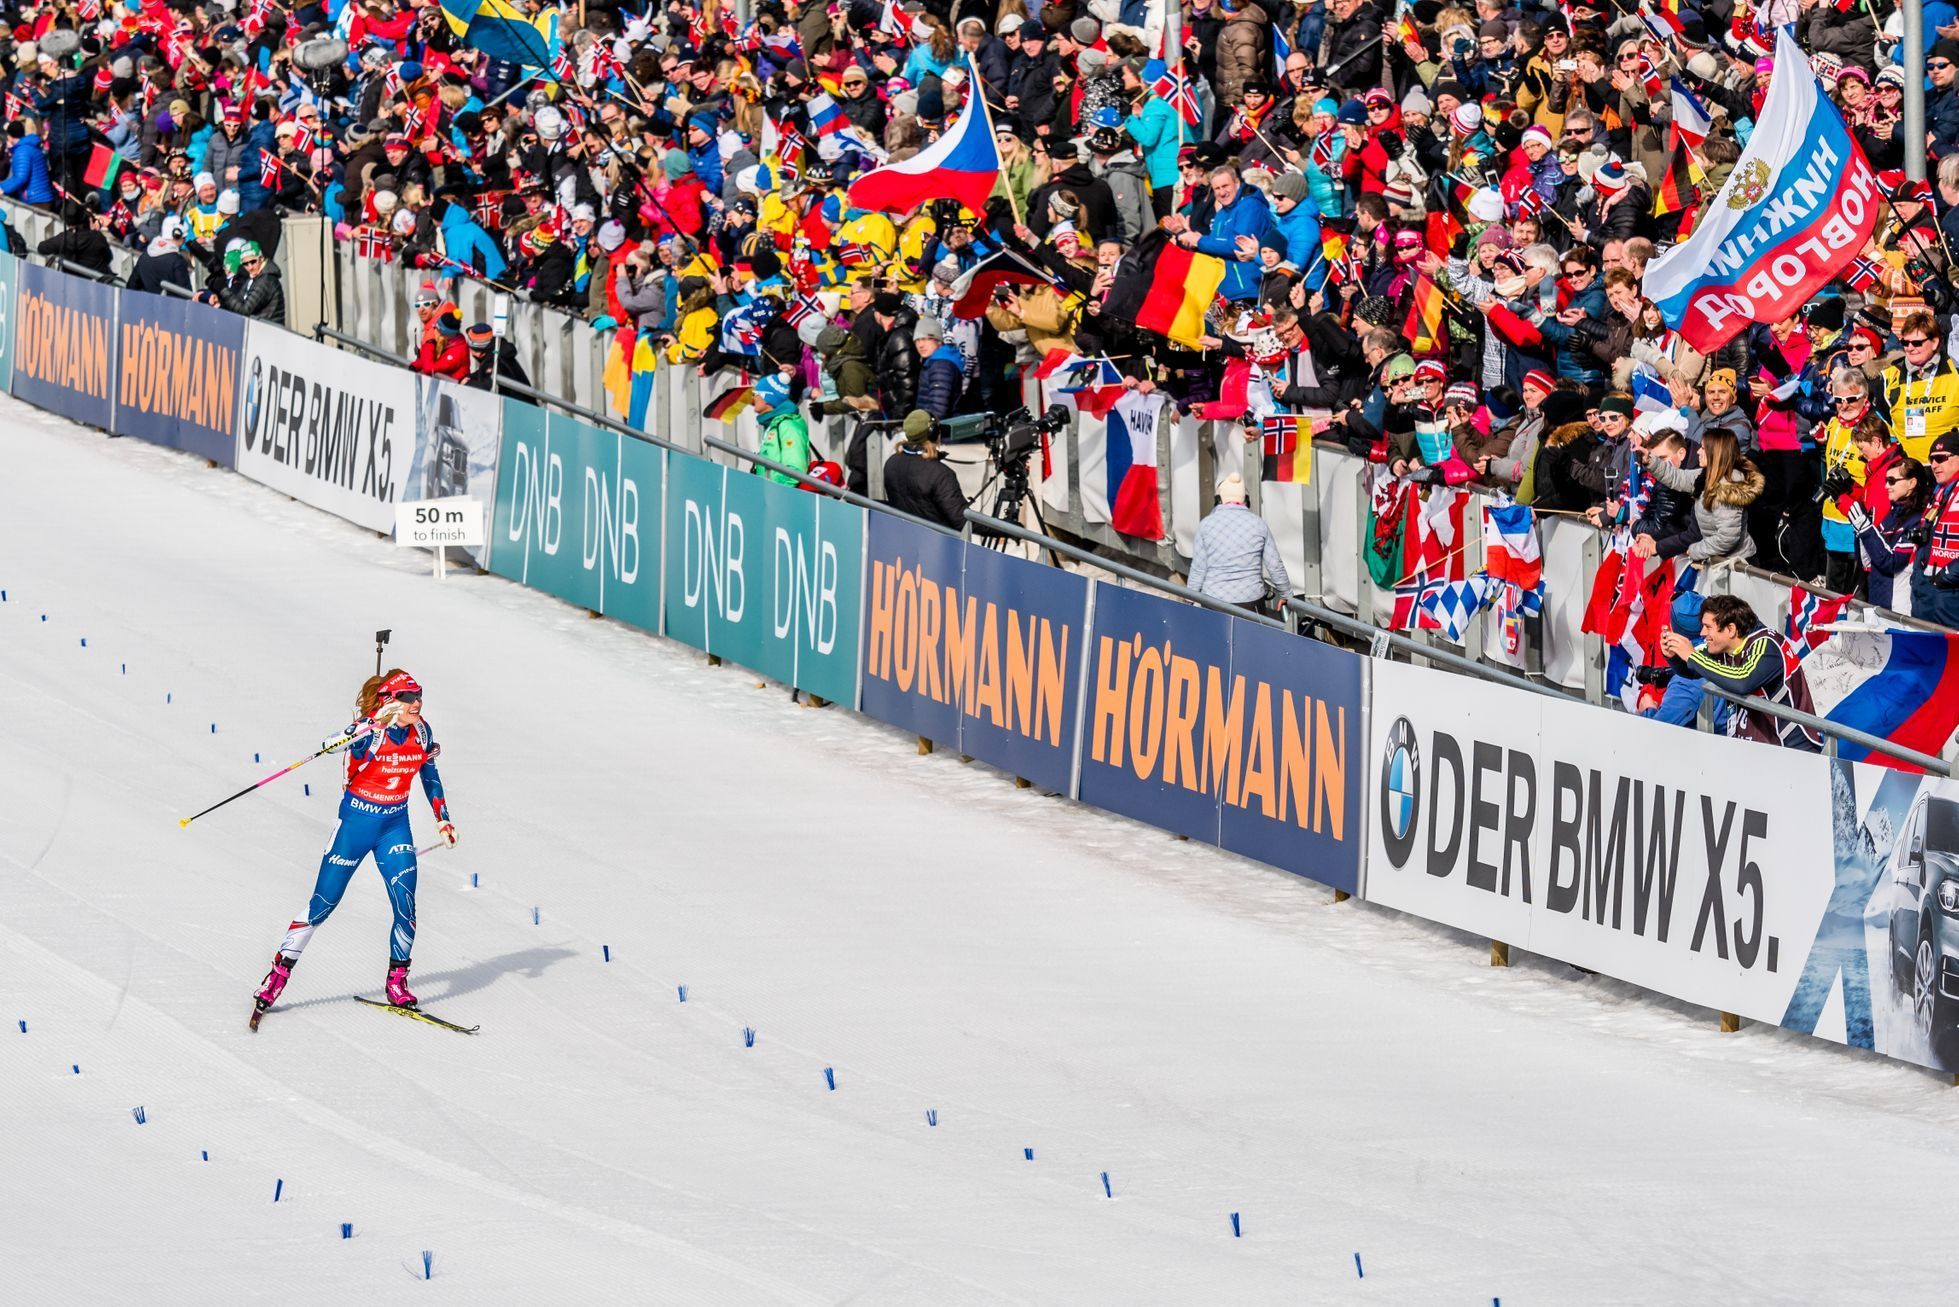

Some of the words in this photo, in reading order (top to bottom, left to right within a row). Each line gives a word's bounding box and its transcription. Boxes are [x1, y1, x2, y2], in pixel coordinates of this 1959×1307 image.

[15, 288, 109, 400] HÖRMANN
[120, 318, 236, 436] HÖRMANN
[261, 365, 306, 469] DER
[305, 382, 364, 490] BMW
[362, 399, 395, 503] X5.
[509, 410, 563, 584] DNB
[414, 529, 427, 541] to
[430, 527, 466, 541] finish
[415, 507, 440, 523] 50
[445, 511, 464, 523] m
[583, 434, 640, 614] DNB
[684, 465, 745, 653] DNB
[774, 493, 838, 688] DNB
[868, 556, 1069, 748] HÖRMANN
[350, 797, 382, 814] BMW
[1091, 631, 1346, 842] HÖRMANN
[1386, 720, 1419, 772] BMW
[1427, 730, 1538, 904] DER
[1546, 760, 1686, 943] BMW
[1690, 794, 1780, 974] X5.
